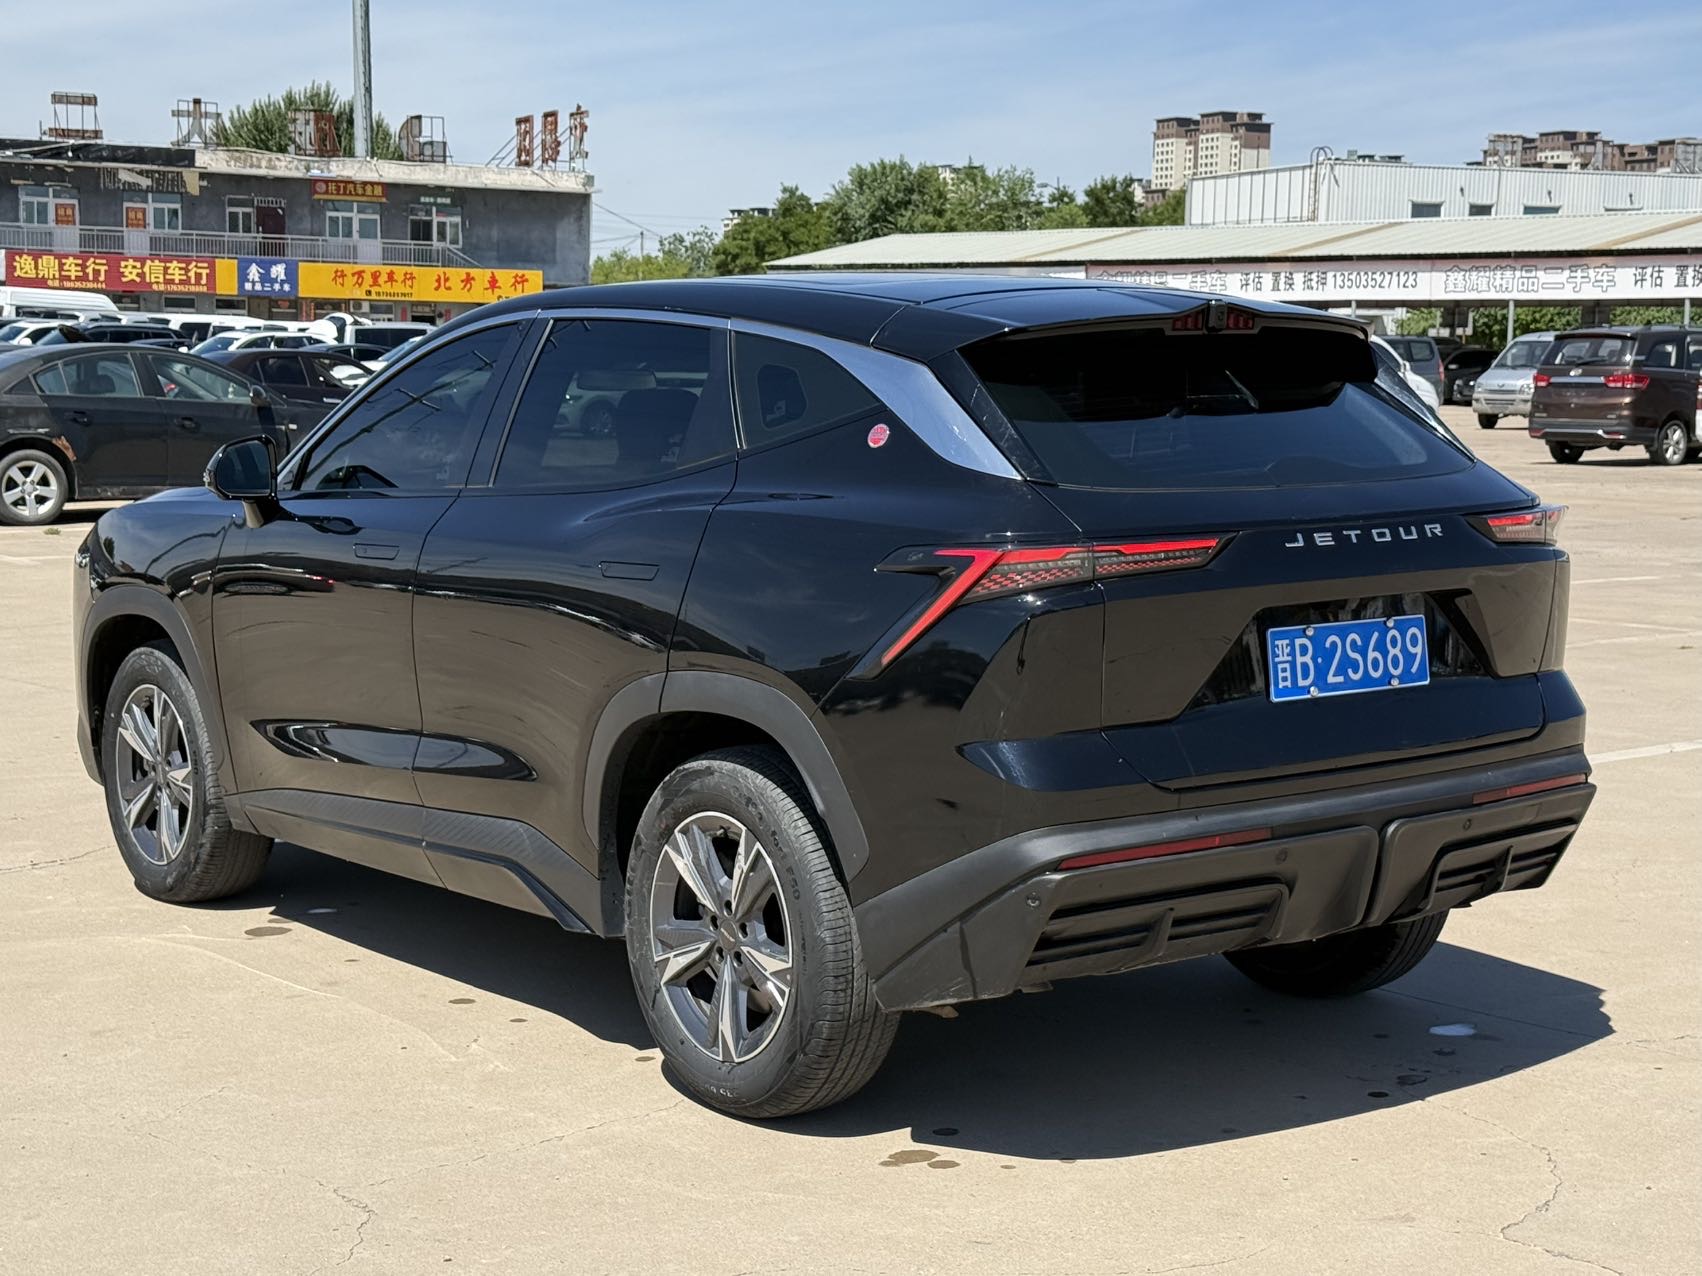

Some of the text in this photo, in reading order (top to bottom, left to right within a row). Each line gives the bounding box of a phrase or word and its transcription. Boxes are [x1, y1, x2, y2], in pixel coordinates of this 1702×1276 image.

[13, 254, 108, 281] 逸鼎车行
[119, 259, 210, 285] 安信车行
[1444, 264, 1616, 293] 鑫耀精品二手车
[1633, 265, 1664, 288] 评估
[1240, 271, 1263, 292] 评估
[1271, 271, 1295, 292] 置换
[1302, 270, 1328, 291] 抵押
[1332, 271, 1418, 290] 13503527123
[1285, 523, 1443, 548] JETOUR
